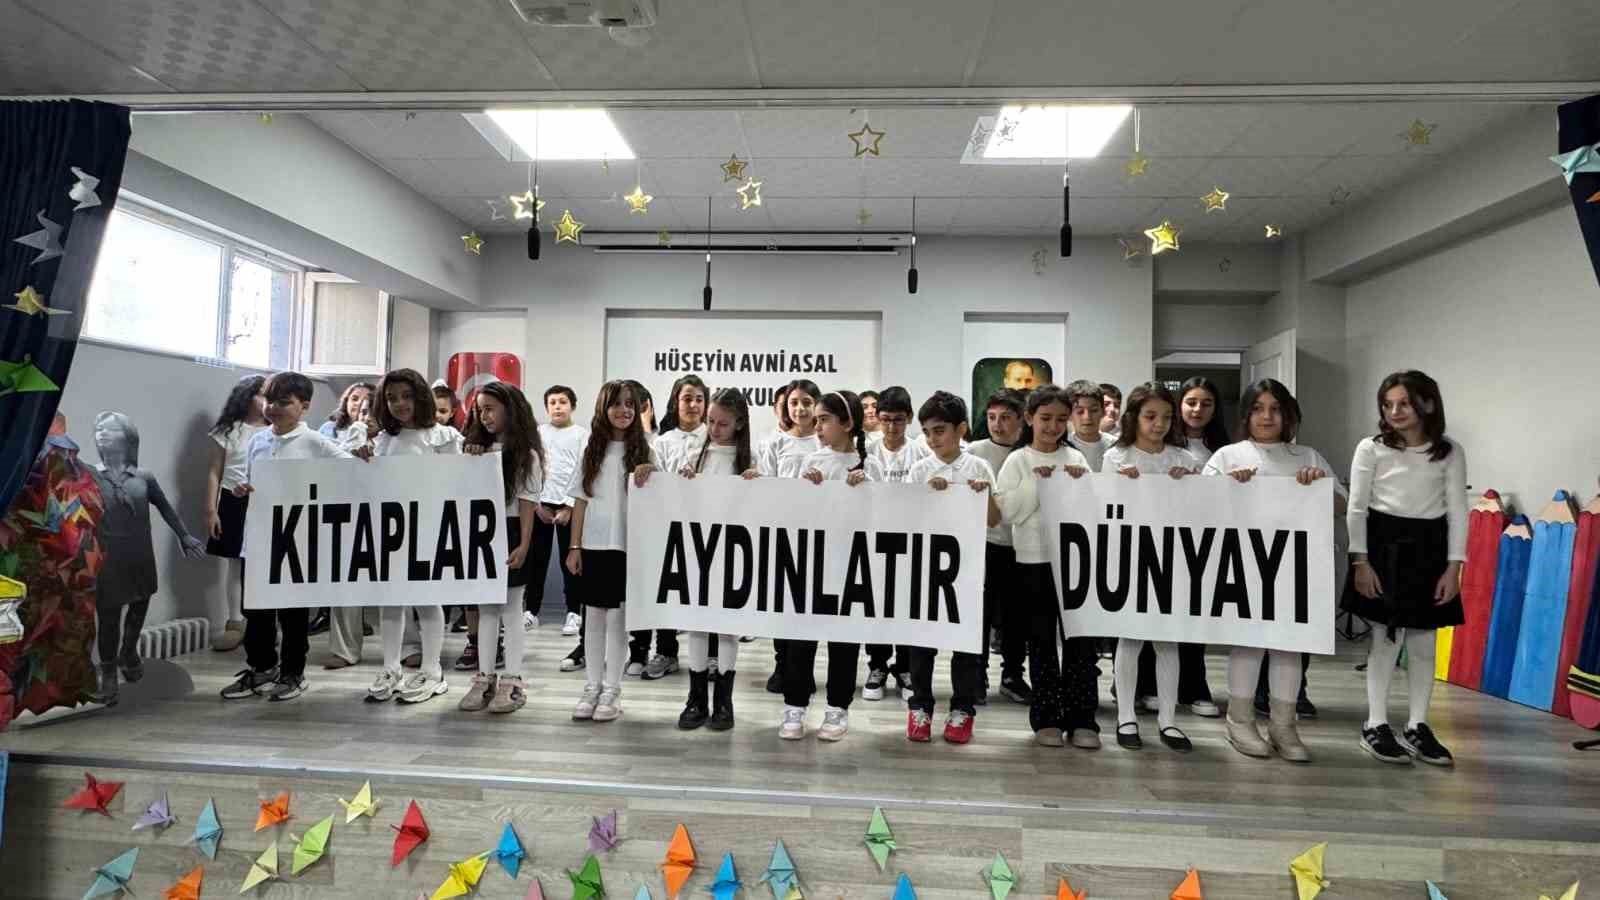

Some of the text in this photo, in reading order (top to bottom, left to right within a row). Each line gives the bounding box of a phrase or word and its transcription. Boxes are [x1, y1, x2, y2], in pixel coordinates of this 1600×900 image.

[655, 348, 838, 373] HÜSEYİN AVNİ ASAL
[269, 483, 498, 585] KİTAPLAR
[655, 520, 961, 624] AYDINLATIR
[1058, 503, 1309, 624] DÜNYAYI
